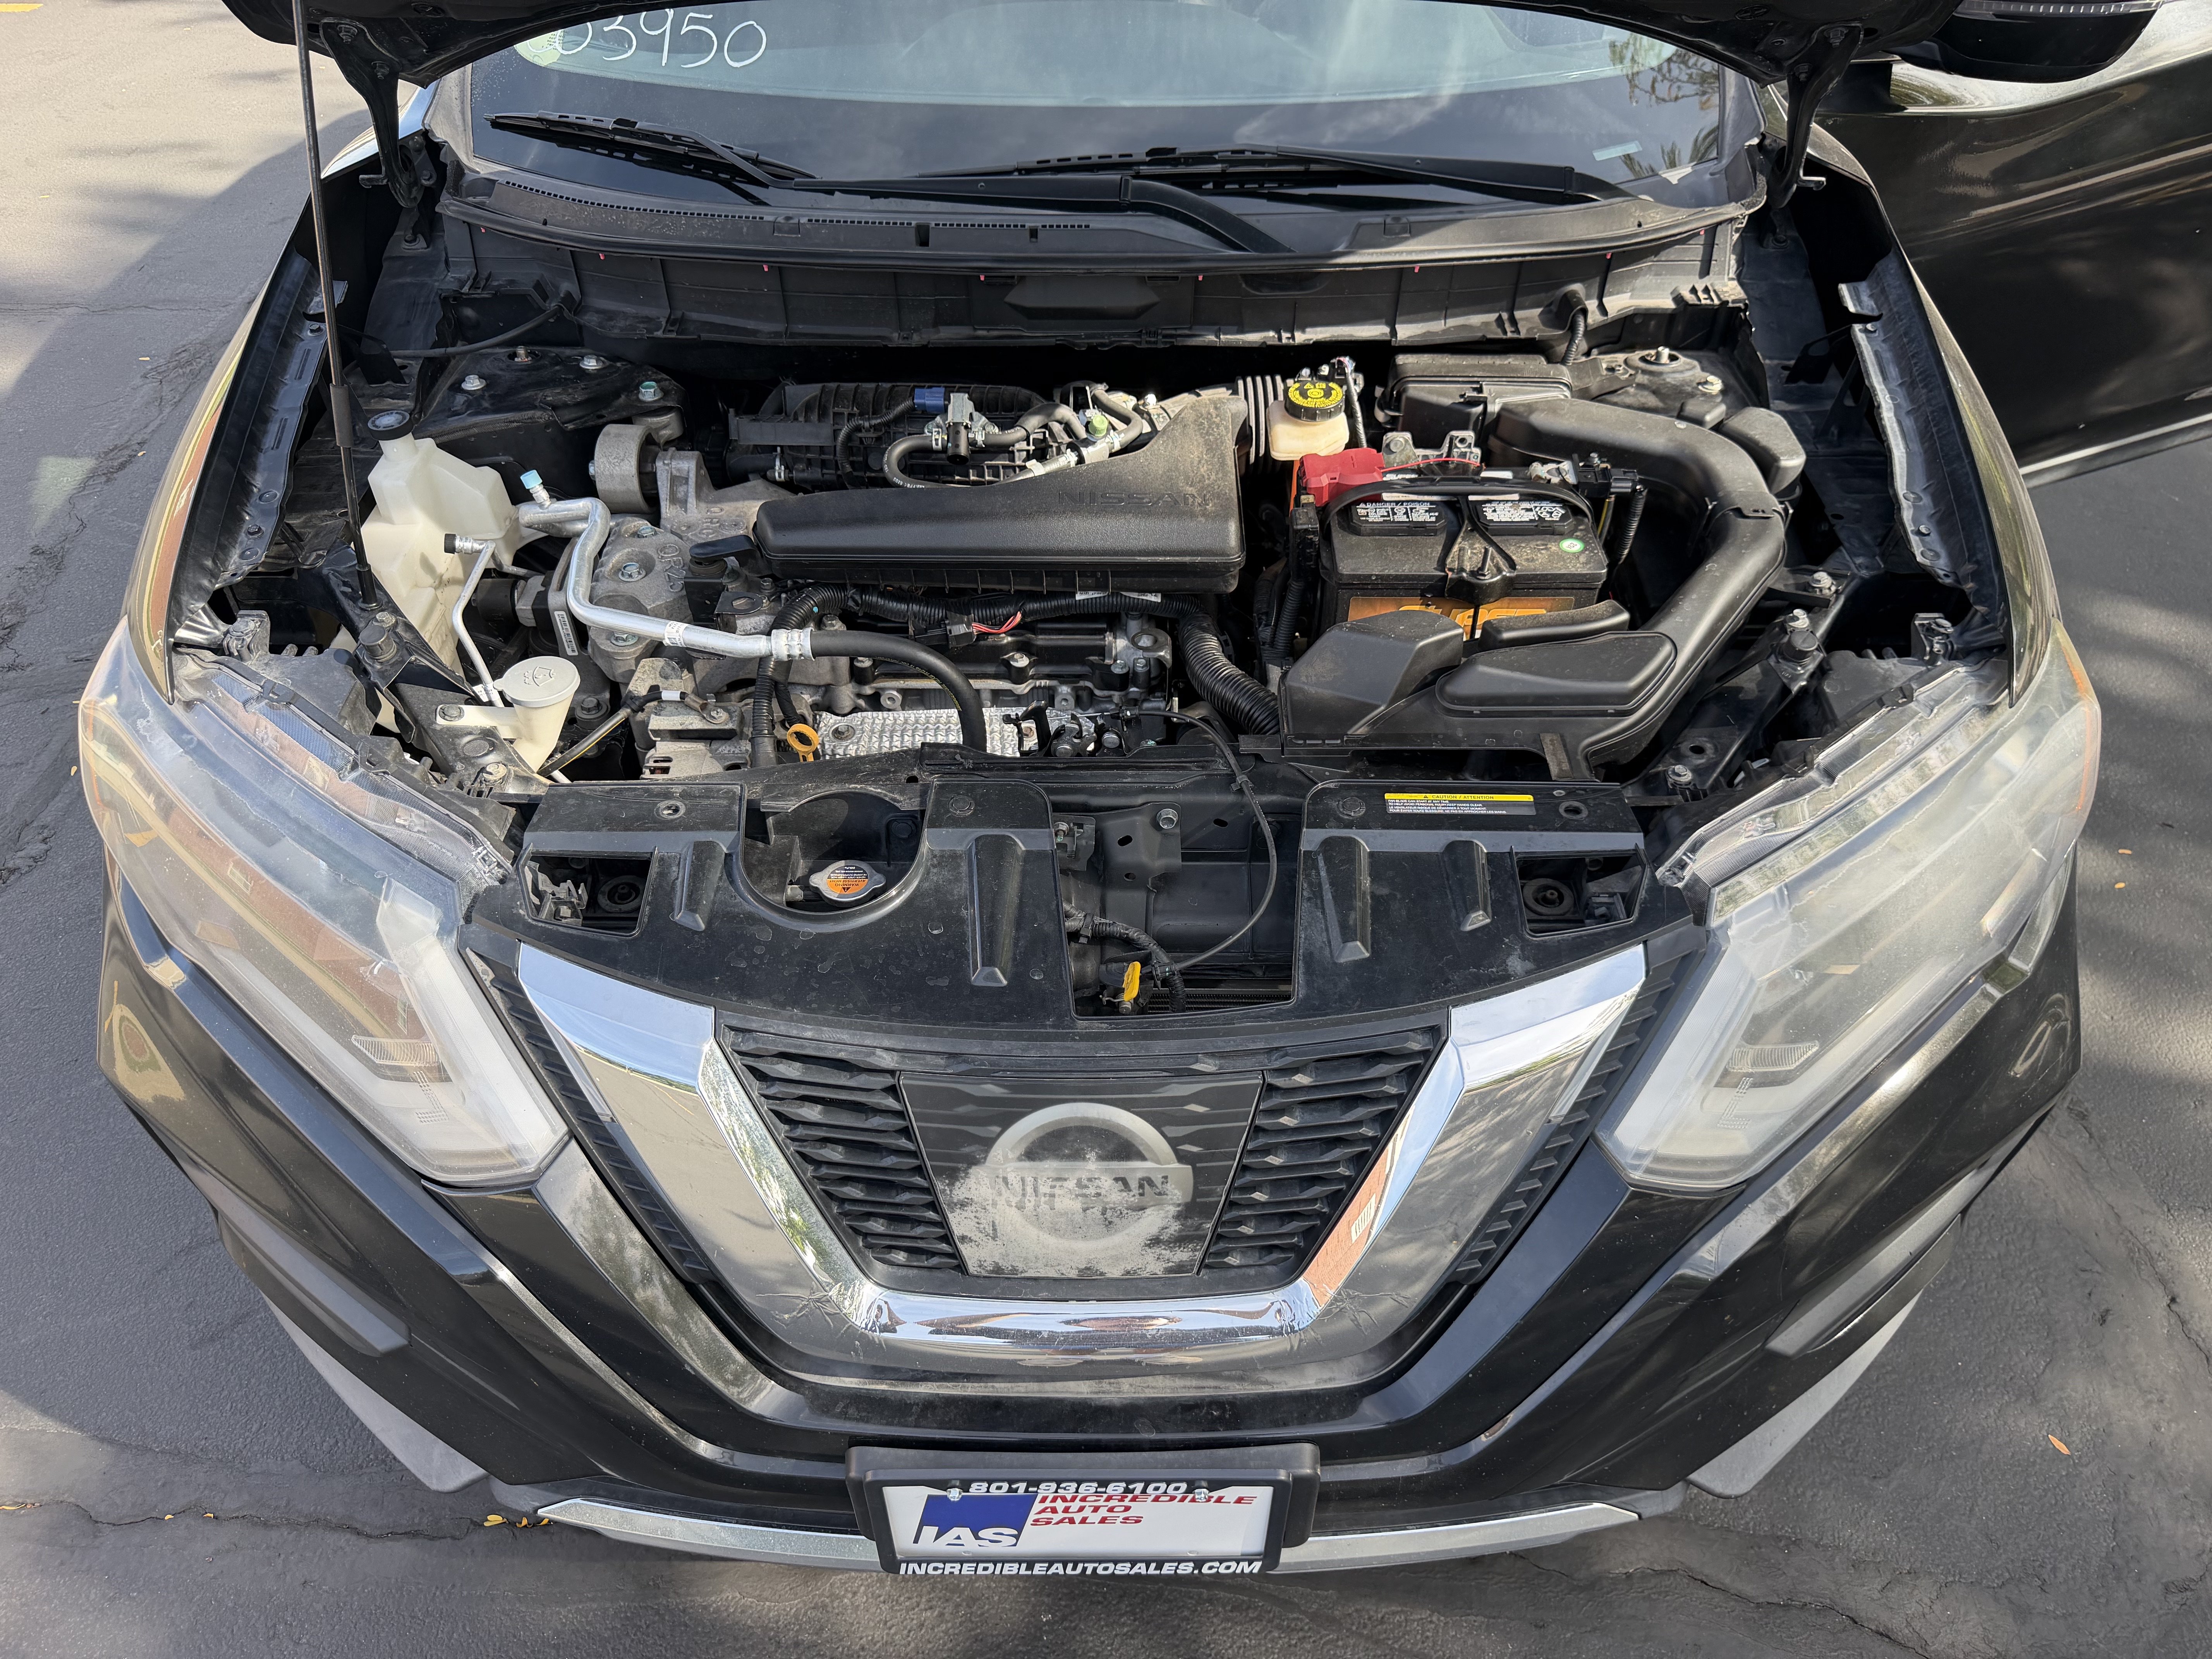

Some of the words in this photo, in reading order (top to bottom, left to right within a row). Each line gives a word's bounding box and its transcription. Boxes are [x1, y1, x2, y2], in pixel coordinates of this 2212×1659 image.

[1058, 491, 1210, 506] NISSAN
[994, 1175, 1169, 1197] NISSAN
[969, 1482, 1187, 1494] 801-936-6100
[1038, 1494, 1257, 1504] INCREDIBLE
[1034, 1505, 1132, 1515] AUTO
[1030, 1516, 1144, 1526] SALES
[916, 1525, 1018, 1547] IAS
[899, 1560, 1263, 1575] INCREDIBLEAUTOSALES.COM
